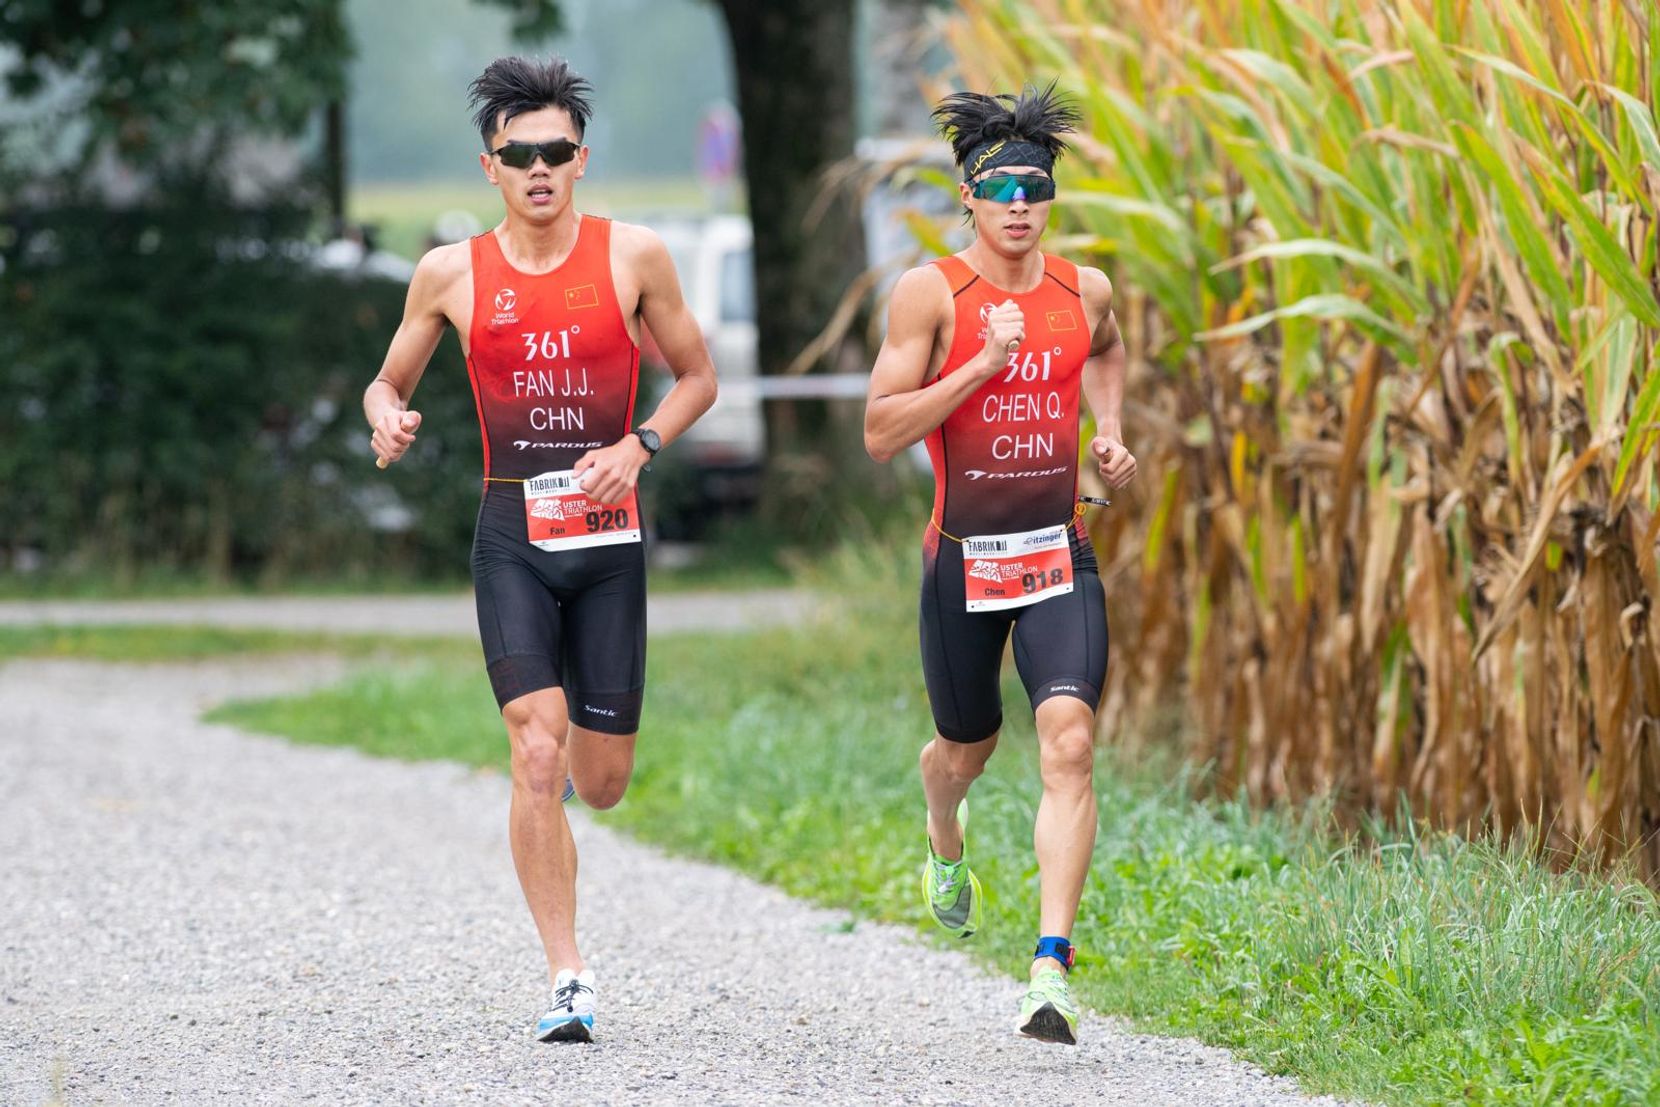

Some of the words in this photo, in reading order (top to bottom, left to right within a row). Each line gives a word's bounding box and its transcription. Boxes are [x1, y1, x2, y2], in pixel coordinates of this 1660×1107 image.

[513, 369, 555, 397] FAN
[561, 367, 594, 397] J.J.
[982, 393, 1040, 423] CHEN
[1046, 391, 1064, 420] Q.
[530, 407, 584, 431] CHN
[531, 441, 602, 449] PARDUS
[991, 432, 1053, 460] CHN
[987, 466, 1068, 480] PARDUS
[563, 500, 587, 508] USTER
[564, 504, 603, 515] TRIATHLON
[585, 508, 629, 533] 920
[550, 526, 566, 536] Fan
[1000, 563, 1024, 571] USTER
[1001, 565, 1038, 578] TRIATHLON
[1022, 569, 1063, 593] 918
[984, 587, 1006, 597] Chen
[584, 704, 617, 717] Santic
